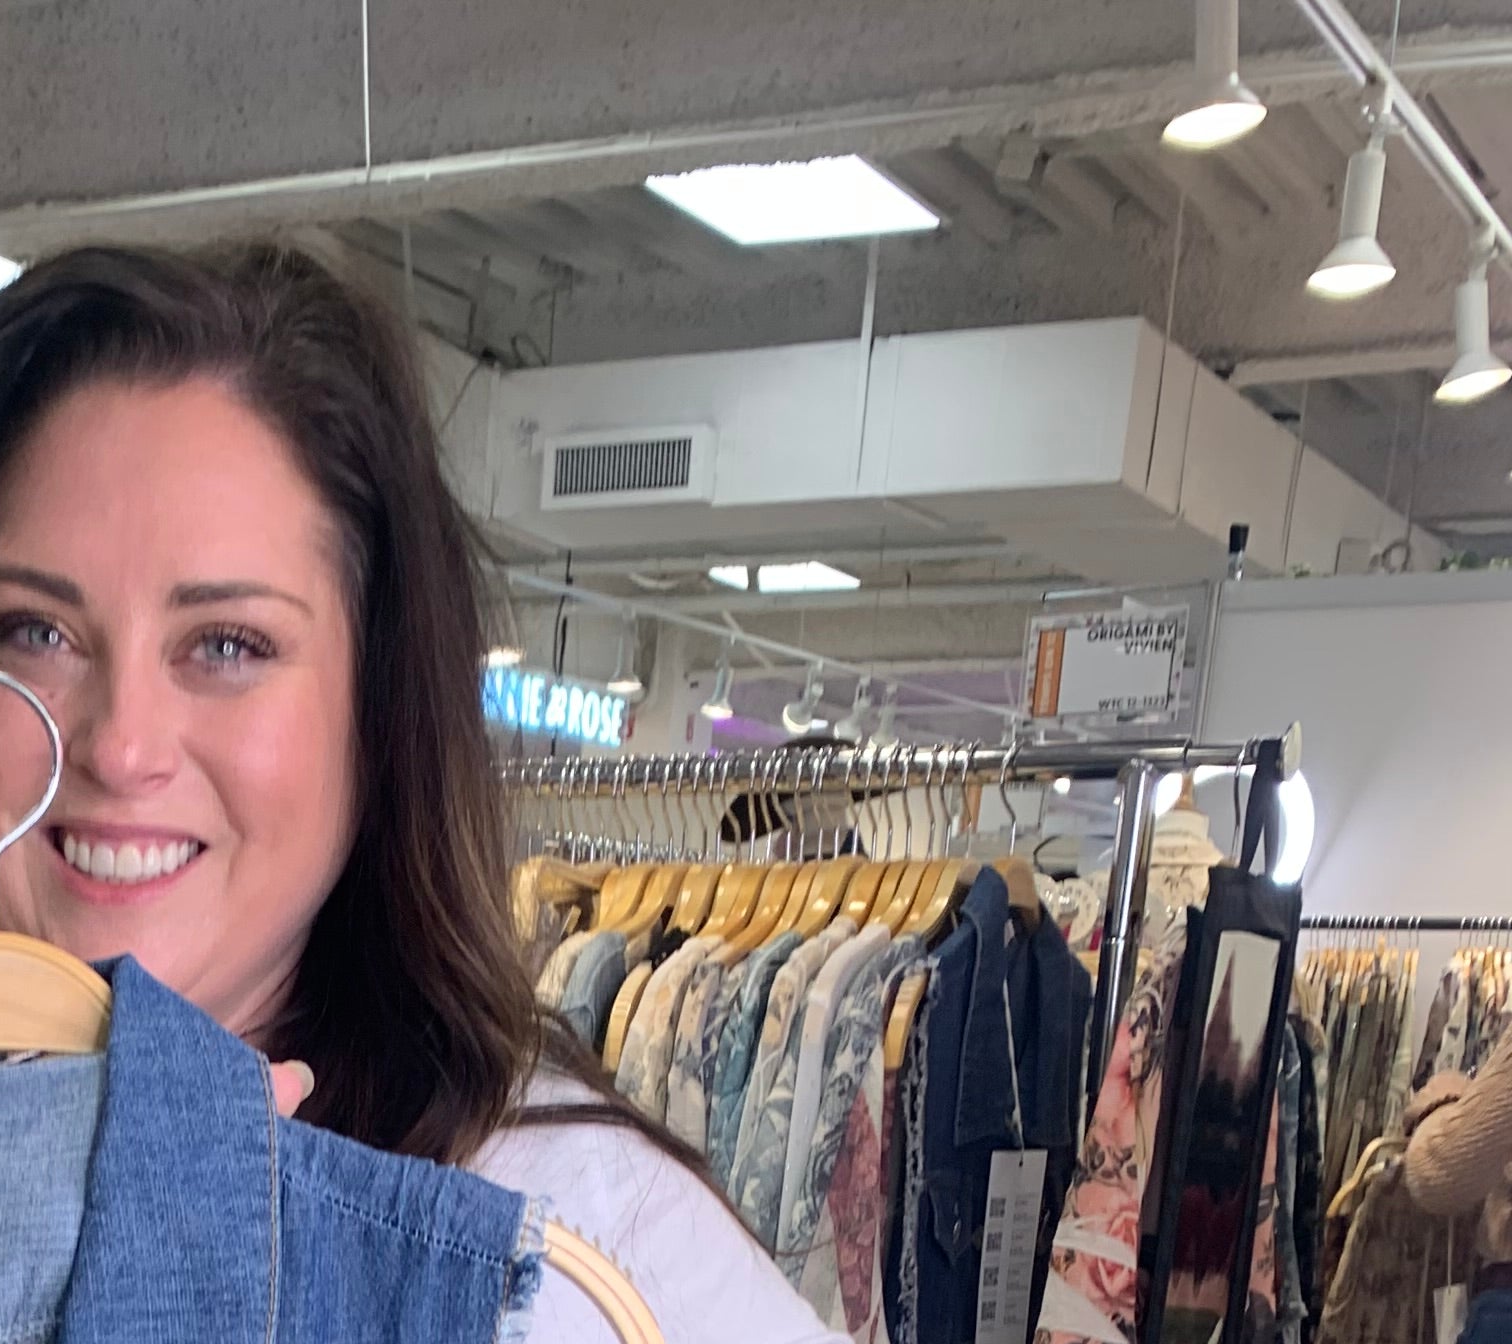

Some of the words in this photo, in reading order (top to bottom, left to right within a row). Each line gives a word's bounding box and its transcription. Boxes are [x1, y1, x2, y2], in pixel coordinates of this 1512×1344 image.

[1087, 621, 1154, 642] ORIGAMI
[1156, 622, 1176, 638] BY
[1124, 637, 1174, 655] VIVIEN
[546, 685, 567, 727] &
[568, 687, 625, 745] ROSE
